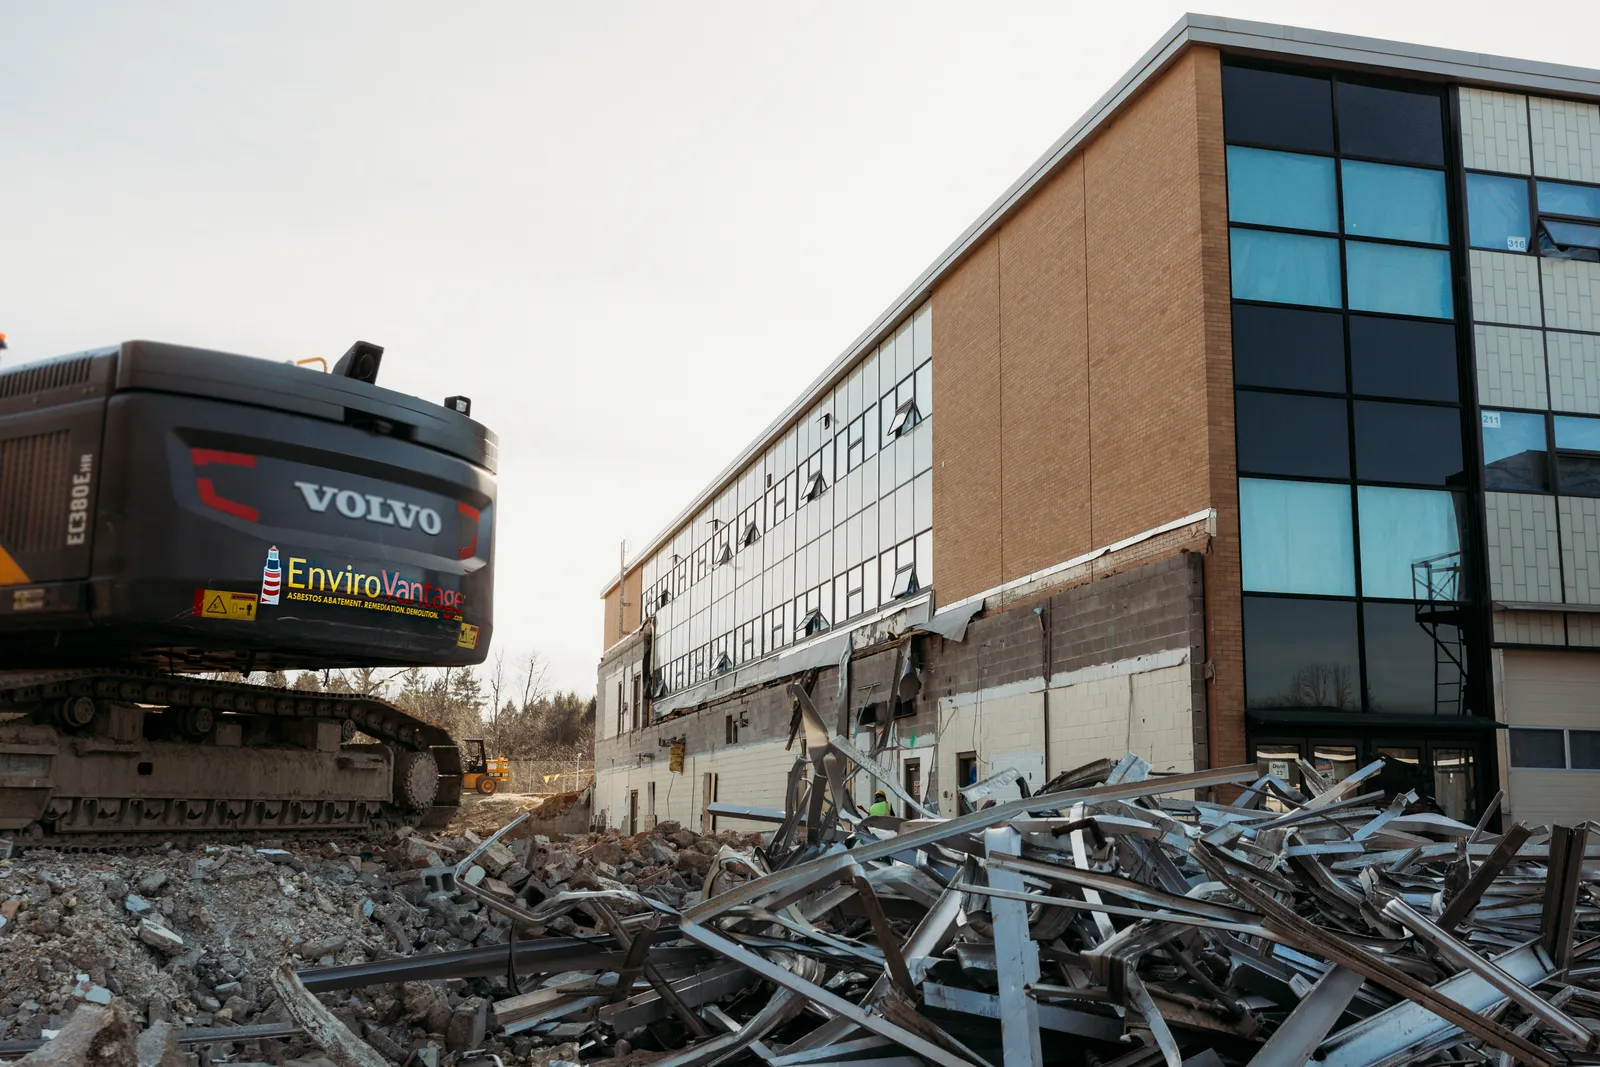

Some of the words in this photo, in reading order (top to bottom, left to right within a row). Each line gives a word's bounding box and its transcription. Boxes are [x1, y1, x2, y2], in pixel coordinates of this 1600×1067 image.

[1508, 239, 1525, 249] 316
[1483, 415, 1499, 424] 211
[294, 481, 442, 536] VOLVO
[287, 556, 465, 619] EnviroVantage
[287, 592, 322, 603] ASBESTOS
[323, 596, 363, 608] ABATEMENT.
